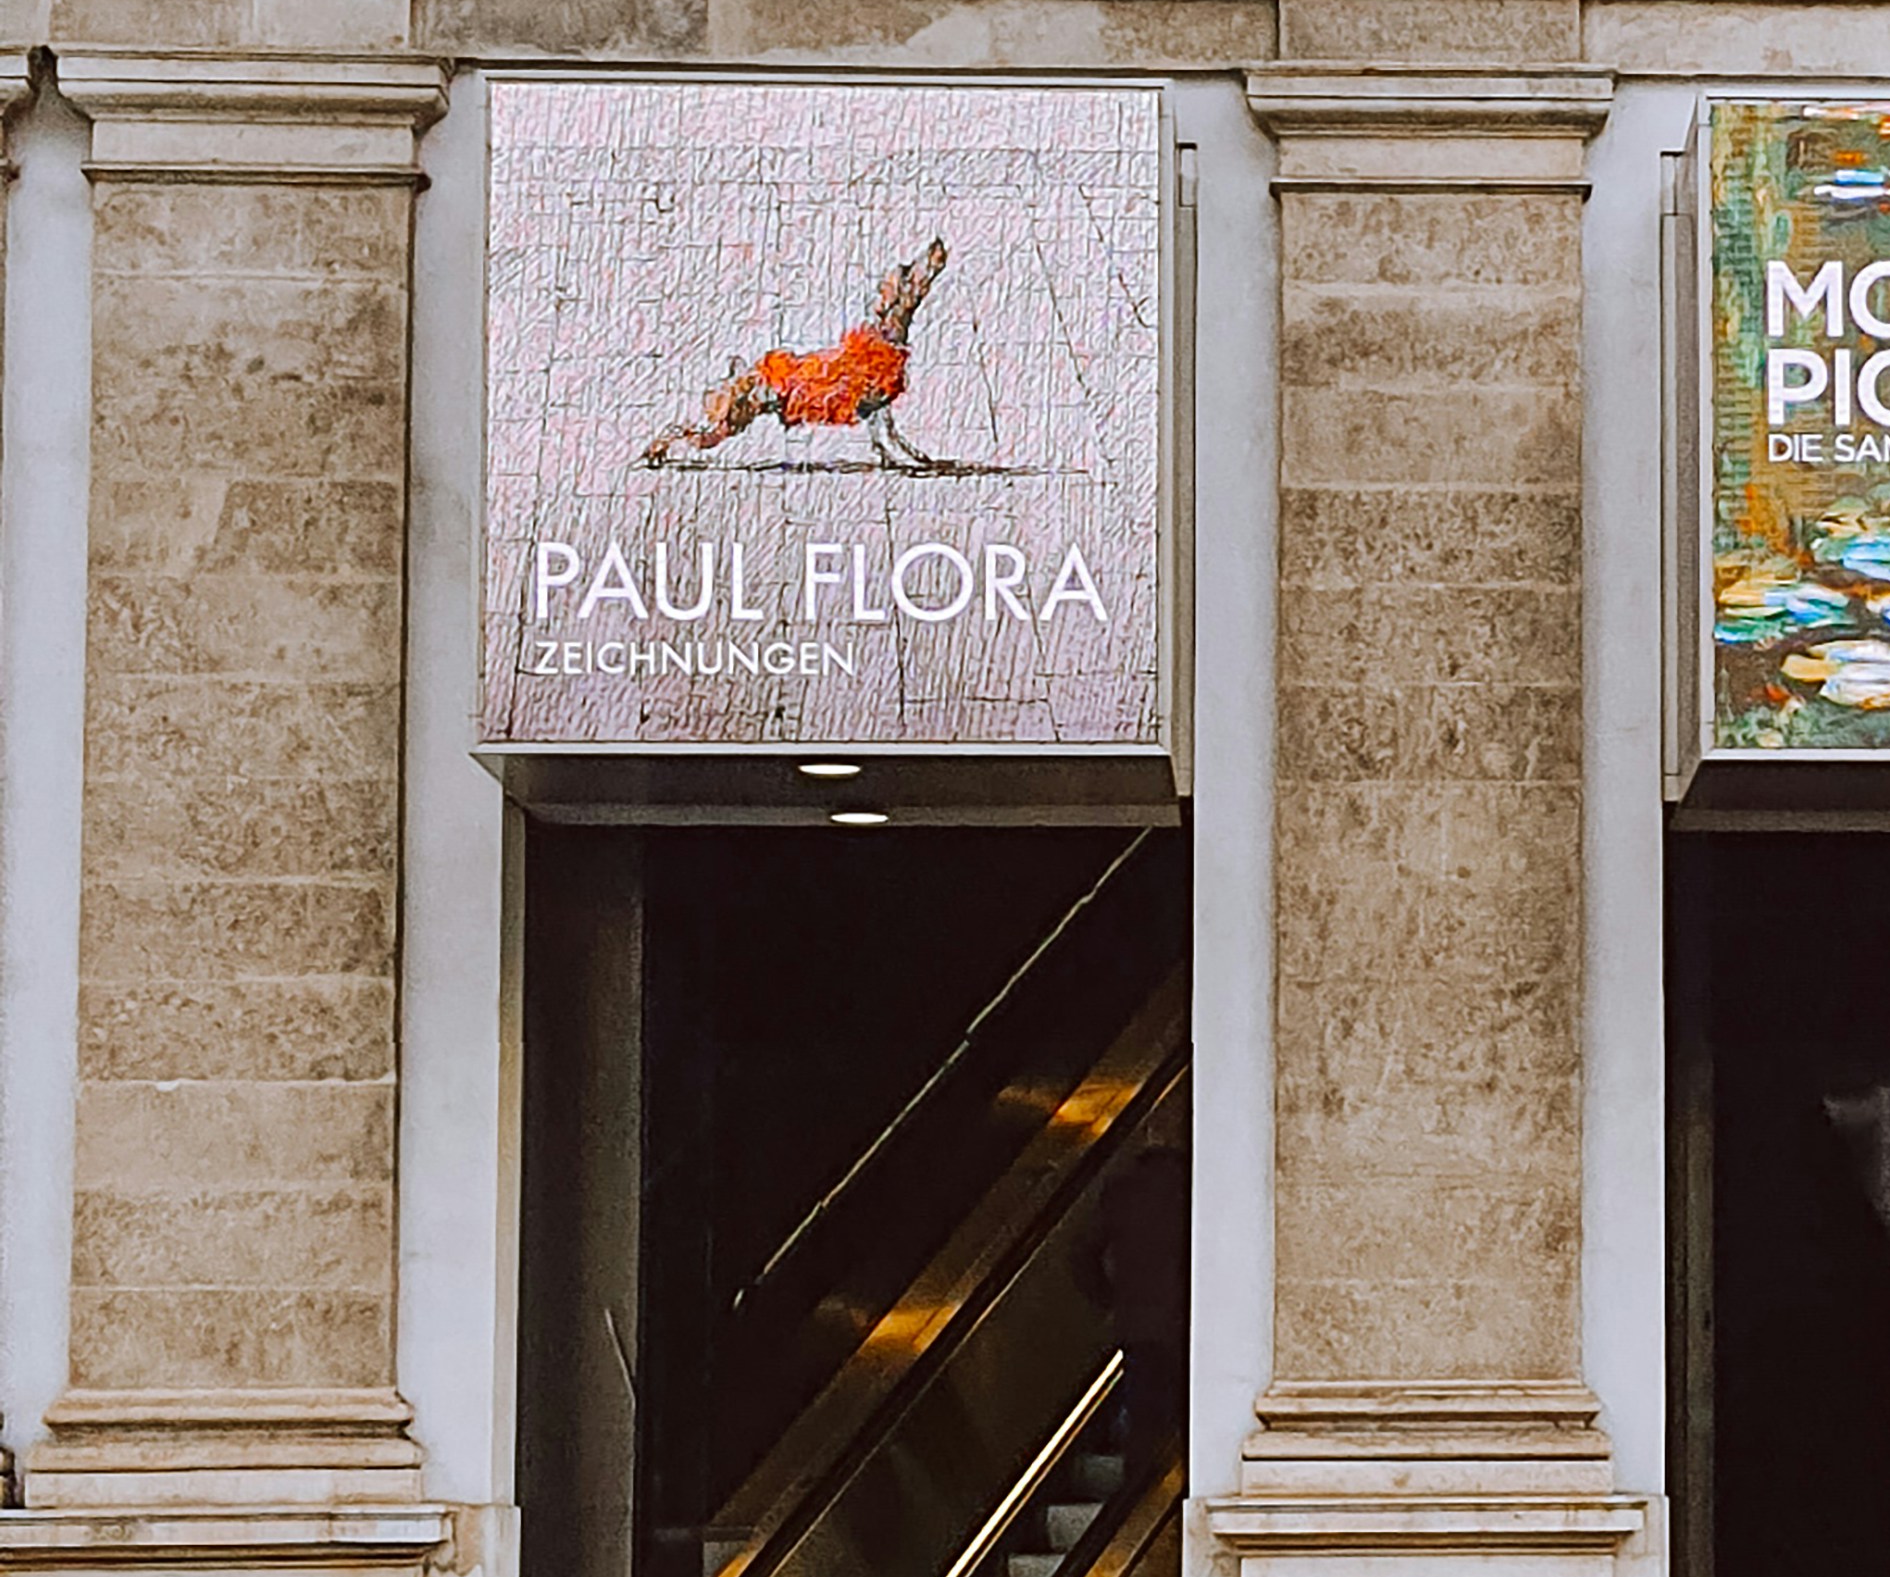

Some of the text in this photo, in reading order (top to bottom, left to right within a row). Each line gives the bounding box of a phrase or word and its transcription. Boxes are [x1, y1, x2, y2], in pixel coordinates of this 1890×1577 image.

[1767, 432, 1824, 463] DIE
[534, 541, 1110, 622] PAUL FLORA
[534, 640, 856, 676] ZEICHNUNGEN
